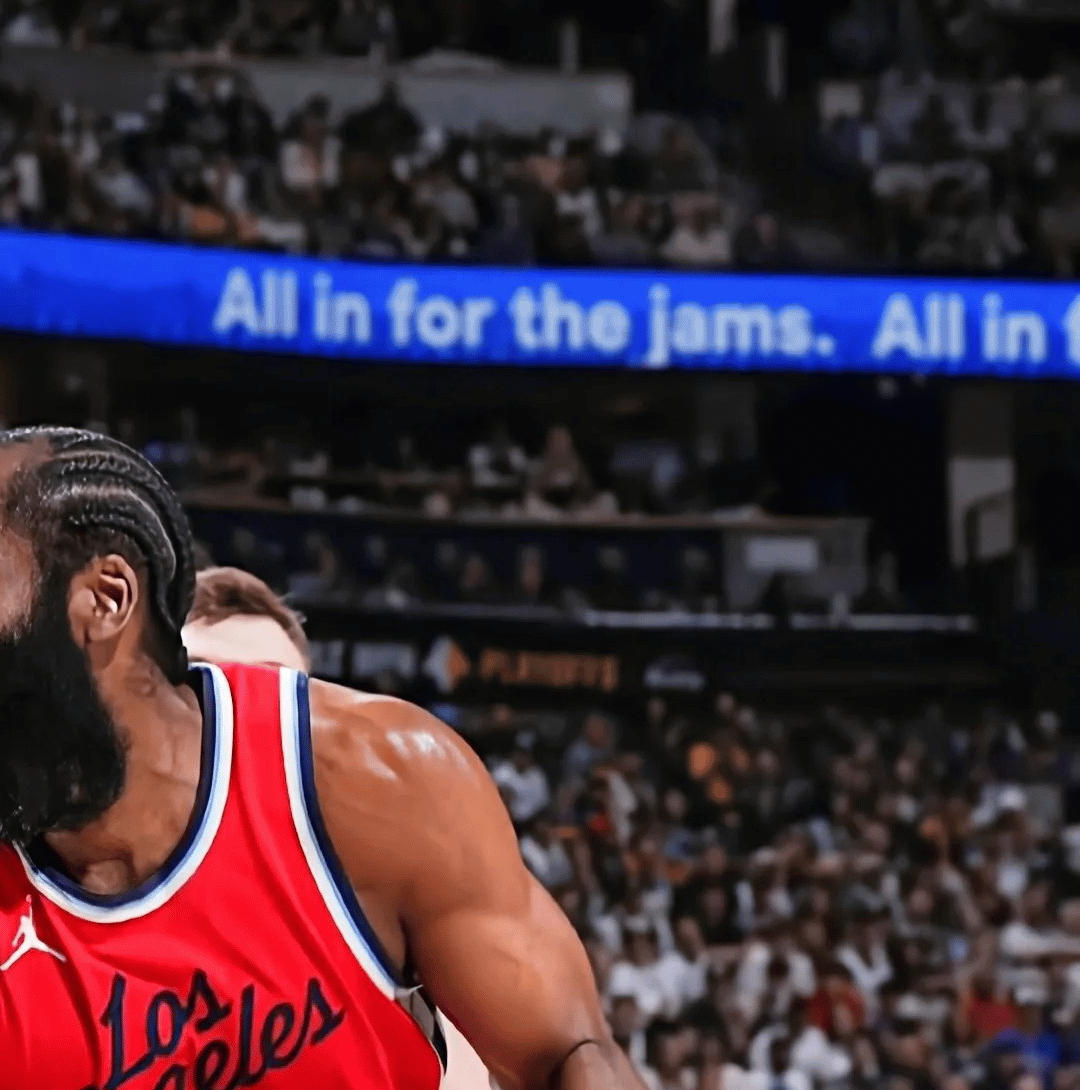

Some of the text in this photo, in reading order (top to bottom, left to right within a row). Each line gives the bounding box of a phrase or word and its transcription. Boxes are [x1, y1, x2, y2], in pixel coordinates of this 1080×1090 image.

[213, 267, 836, 368] All in for the jams.
[871, 292, 965, 361] All
[983, 292, 1047, 363] in
